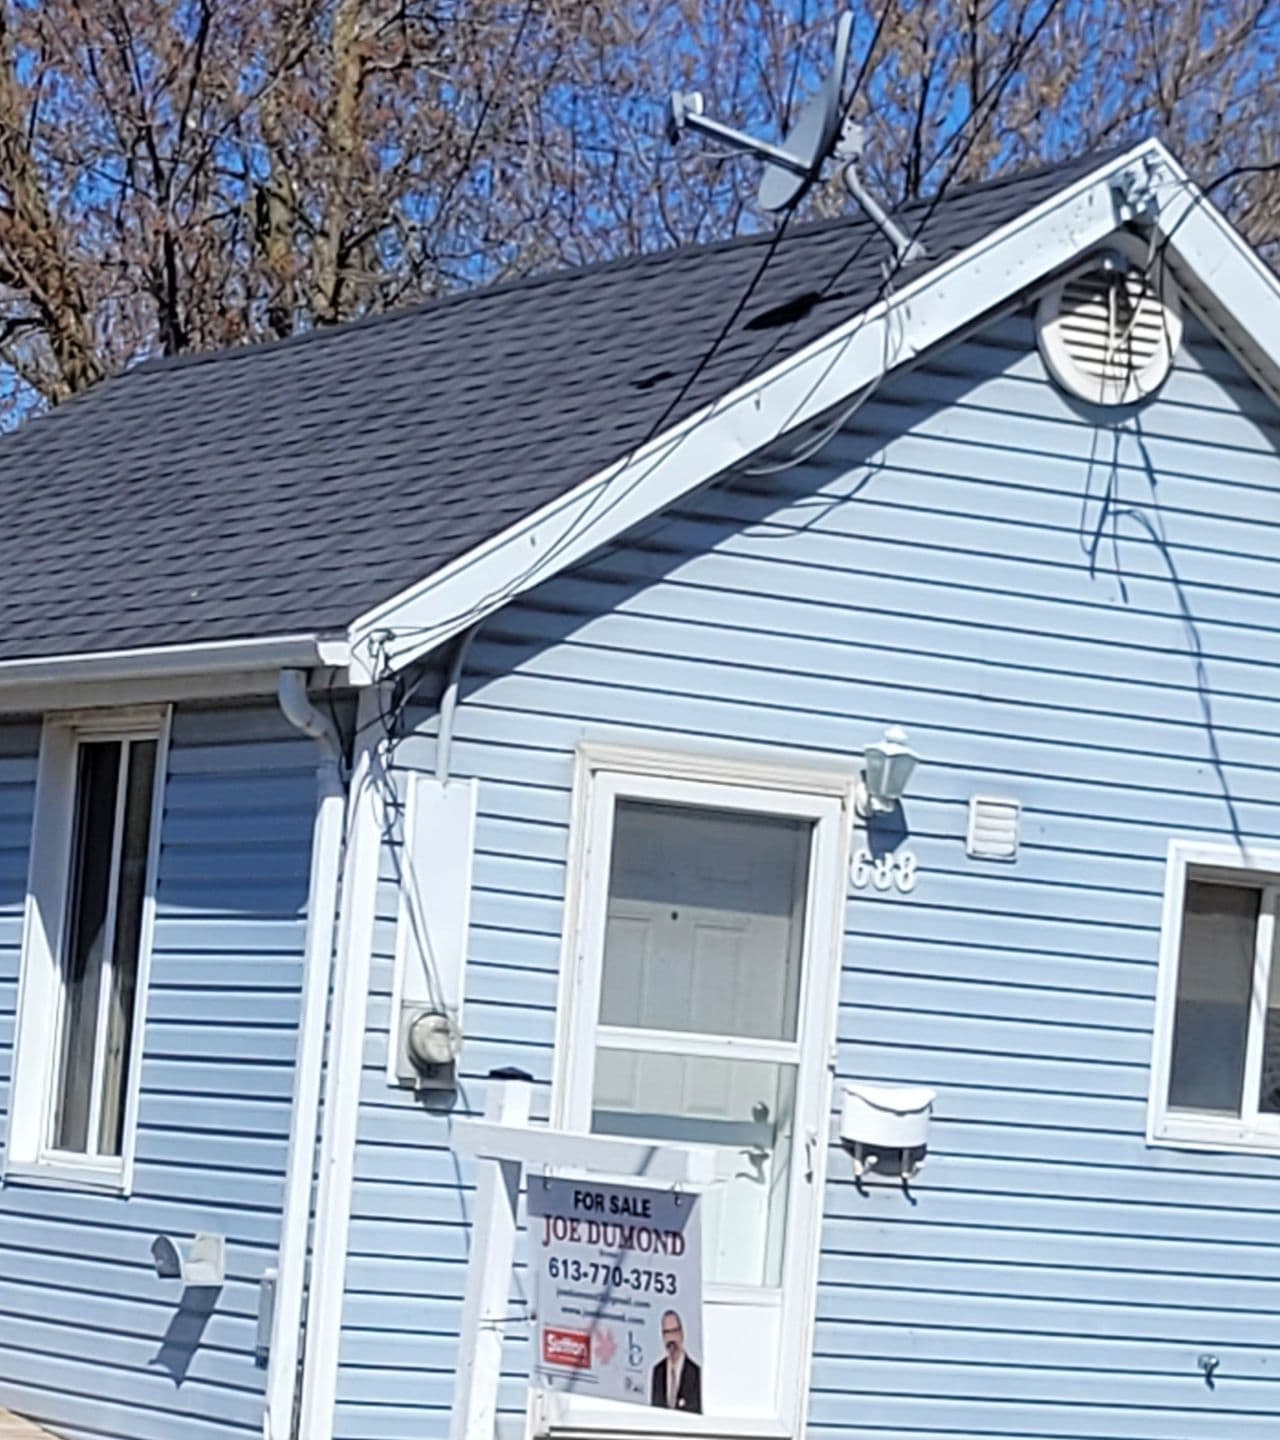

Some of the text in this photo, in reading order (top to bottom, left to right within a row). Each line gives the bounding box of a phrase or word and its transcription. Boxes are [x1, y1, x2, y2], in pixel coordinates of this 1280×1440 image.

[850, 850, 917, 892] 688
[573, 1189, 652, 1218] FOR SALE
[542, 1214, 686, 1257] JOE DUMOND
[548, 1257, 677, 1295] 613-770-3753
